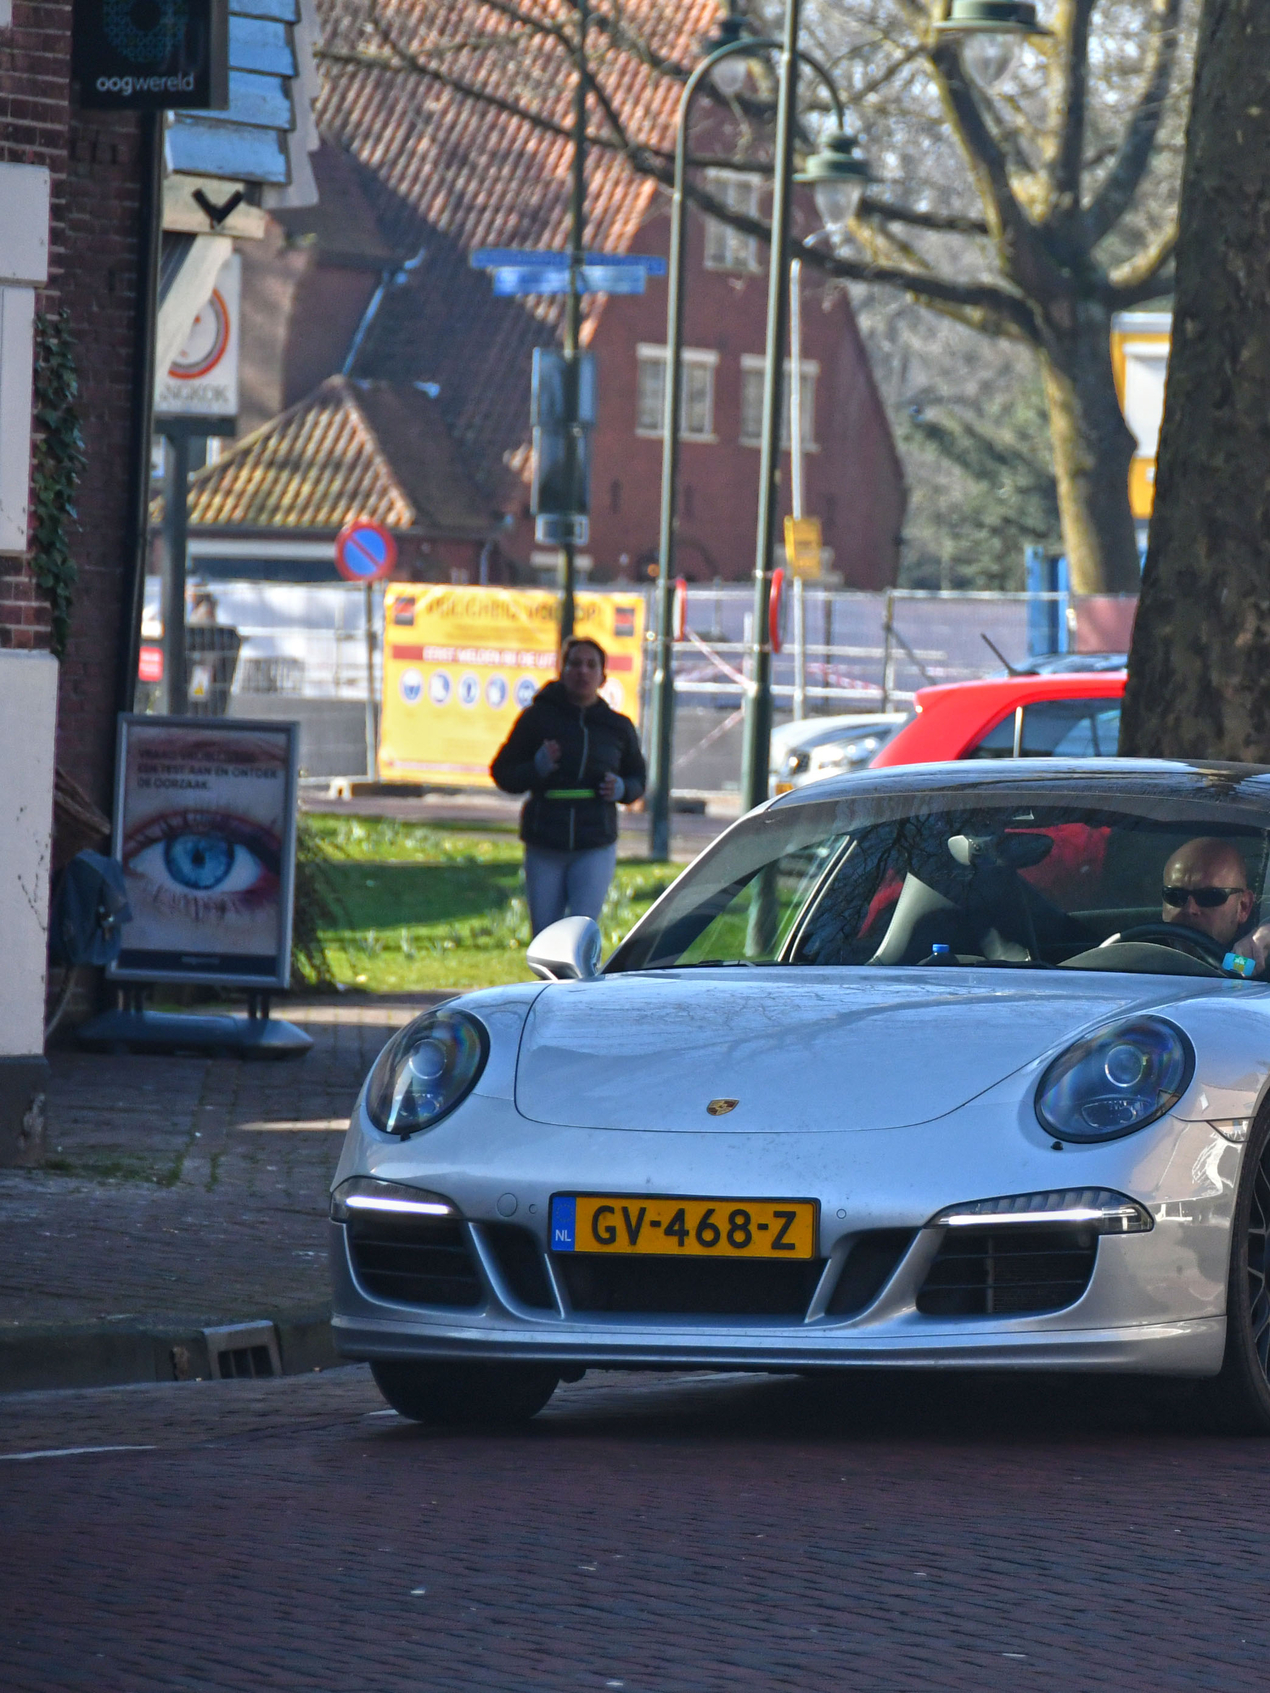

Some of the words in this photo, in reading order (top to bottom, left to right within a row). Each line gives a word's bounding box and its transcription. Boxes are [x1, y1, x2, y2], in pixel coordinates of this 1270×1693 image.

[96, 72, 195, 97] oogwereld
[554, 1229, 572, 1242] NL
[591, 1205, 797, 1251] GV-468-Z
